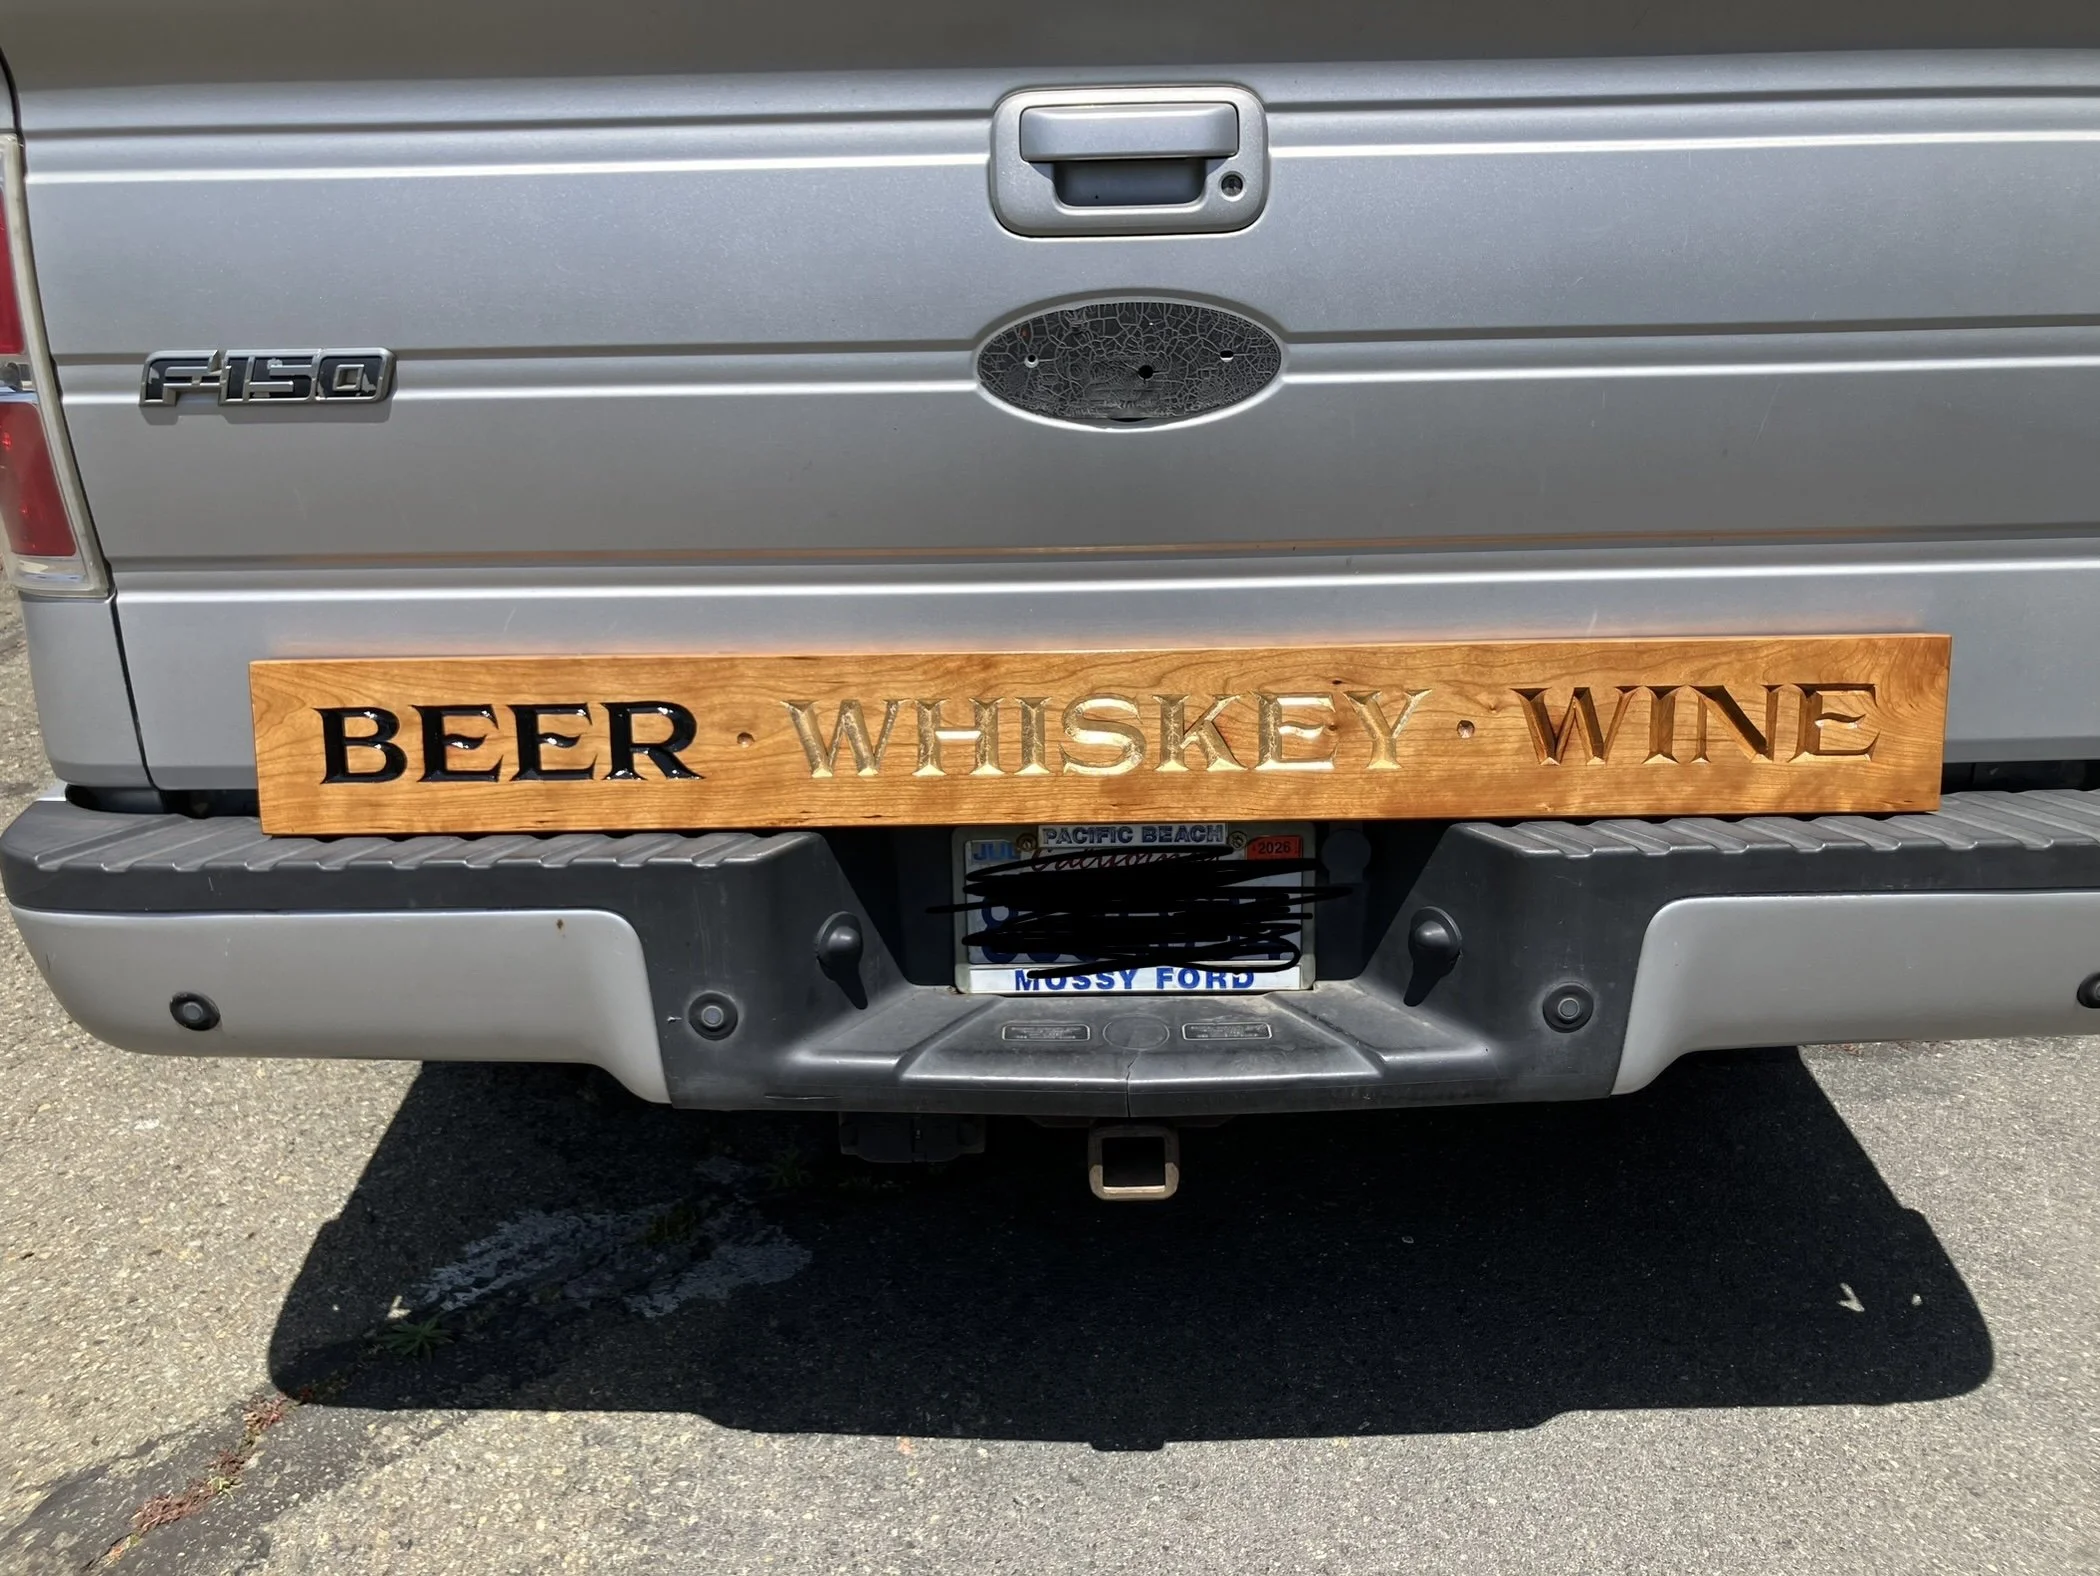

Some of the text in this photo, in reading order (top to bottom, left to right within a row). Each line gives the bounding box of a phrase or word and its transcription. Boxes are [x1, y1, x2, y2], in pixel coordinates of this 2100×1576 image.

[139, 348, 395, 406] F-150
[313, 682, 1880, 785] BEER WHISKEY WINE
[1042, 824, 1224, 845] PACIFIC BEACH
[1258, 841, 1292, 855] 2026
[1014, 966, 1255, 992] MOSSY FORD
